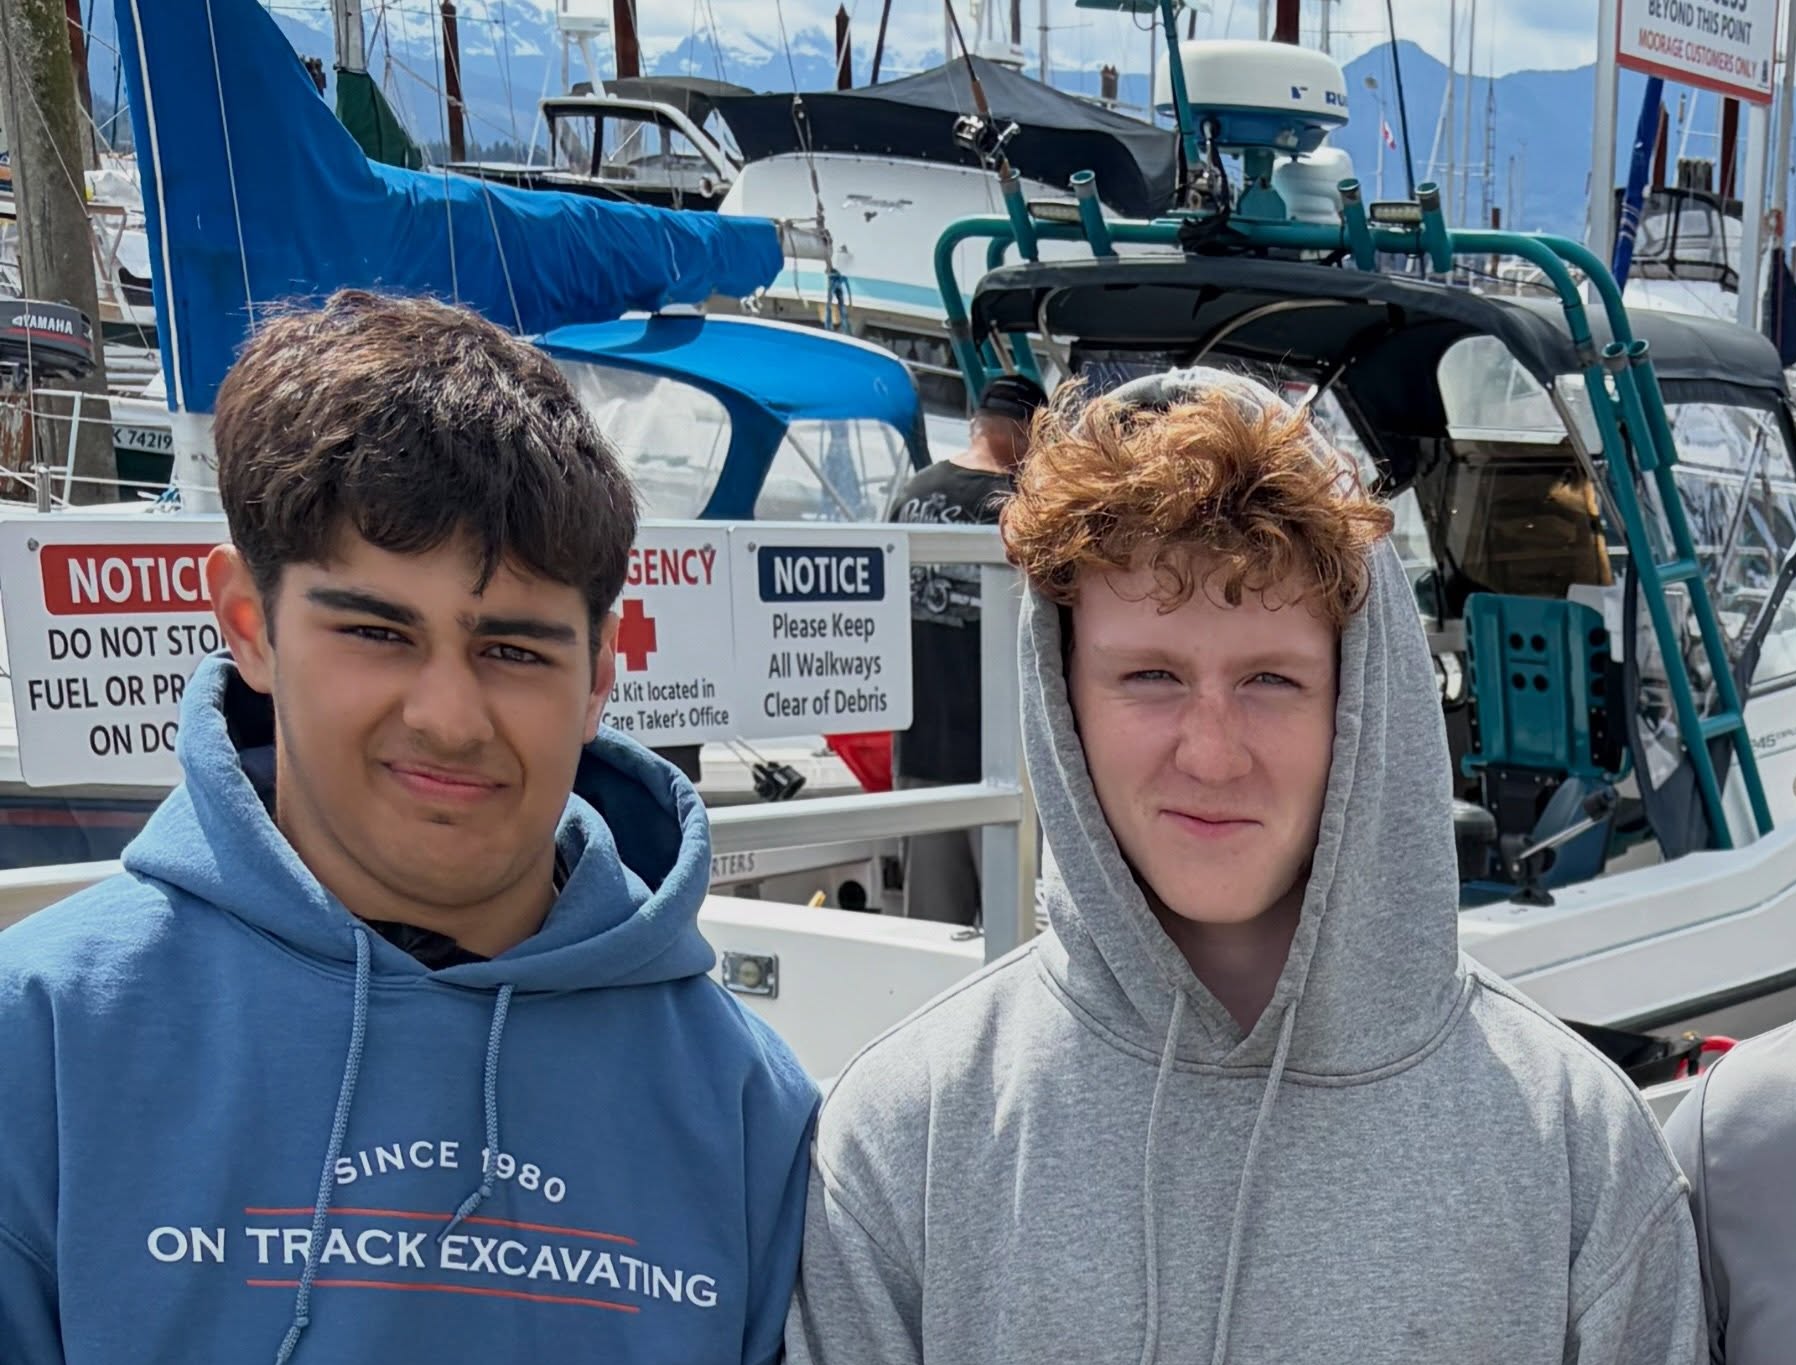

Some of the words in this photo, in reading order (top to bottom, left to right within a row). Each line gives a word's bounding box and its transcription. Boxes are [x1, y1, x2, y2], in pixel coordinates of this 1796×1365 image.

[1648, 0, 1694, 27] BEYOND
[1697, 6, 1719, 35] THIS
[1721, 14, 1752, 45] POINT
[1638, 28, 1684, 59] MOORAGE
[1685, 42, 1734, 73] CUSTOMERS
[1734, 57, 1757, 79] ONLY
[25, 314, 73, 335] YAMAHA
[128, 430, 172, 449] 74219
[626, 549, 717, 586] GENCY
[773, 556, 870, 595] NOTICE
[48, 628, 91, 660] DO
[100, 626, 158, 658] NOT
[167, 624, 227, 656] STO
[772, 613, 827, 639] Please
[831, 612, 875, 643] Keep
[768, 652, 792, 679] All
[797, 651, 881, 681] Walkways
[28, 677, 98, 711] FUEL
[105, 675, 146, 706] OR
[153, 673, 186, 704] PR
[623, 681, 644, 703] Kit
[647, 678, 699, 702] located
[702, 677, 715, 699] in
[764, 691, 808, 718] Clear
[812, 689, 831, 715] of
[834, 686, 887, 714] Debris
[602, 712, 634, 731] Care
[637, 709, 685, 731] Taker's
[689, 706, 729, 727] Office
[90, 724, 133, 756] ON
[140, 721, 179, 754] DO
[711, 852, 755, 877] RTERS
[334, 1140, 460, 1185] SINCE
[480, 1147, 567, 1204] 1980
[146, 1226, 227, 1264] ON
[244, 1226, 426, 1269] TRACK
[439, 1233, 719, 1308] EXCAVATING
